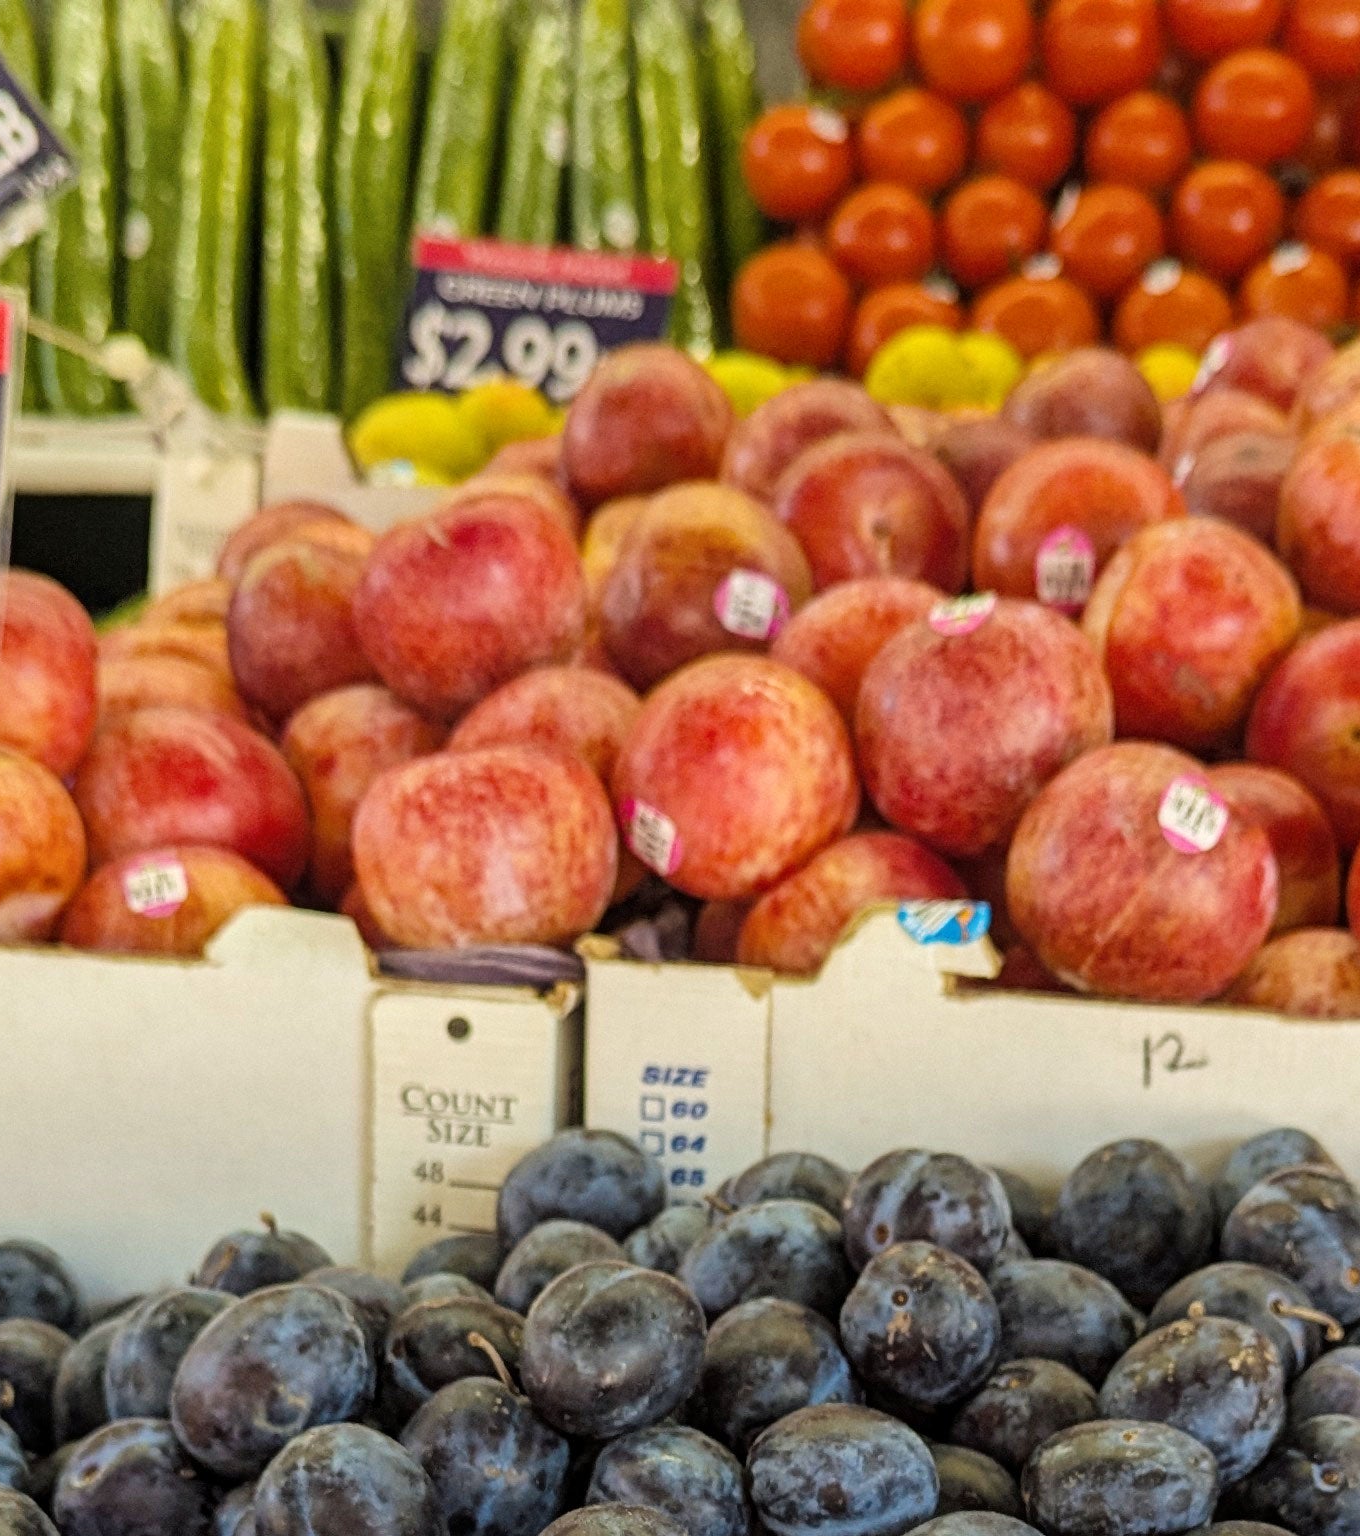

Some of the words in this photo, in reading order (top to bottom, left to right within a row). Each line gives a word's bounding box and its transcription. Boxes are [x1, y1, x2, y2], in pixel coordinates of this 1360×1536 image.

[642, 1064, 710, 1088] SIZE
[401, 1083, 518, 1119] COUNT
[670, 1101, 708, 1120] 60
[426, 1119, 491, 1149] SIZE
[413, 1161, 444, 1184] 48
